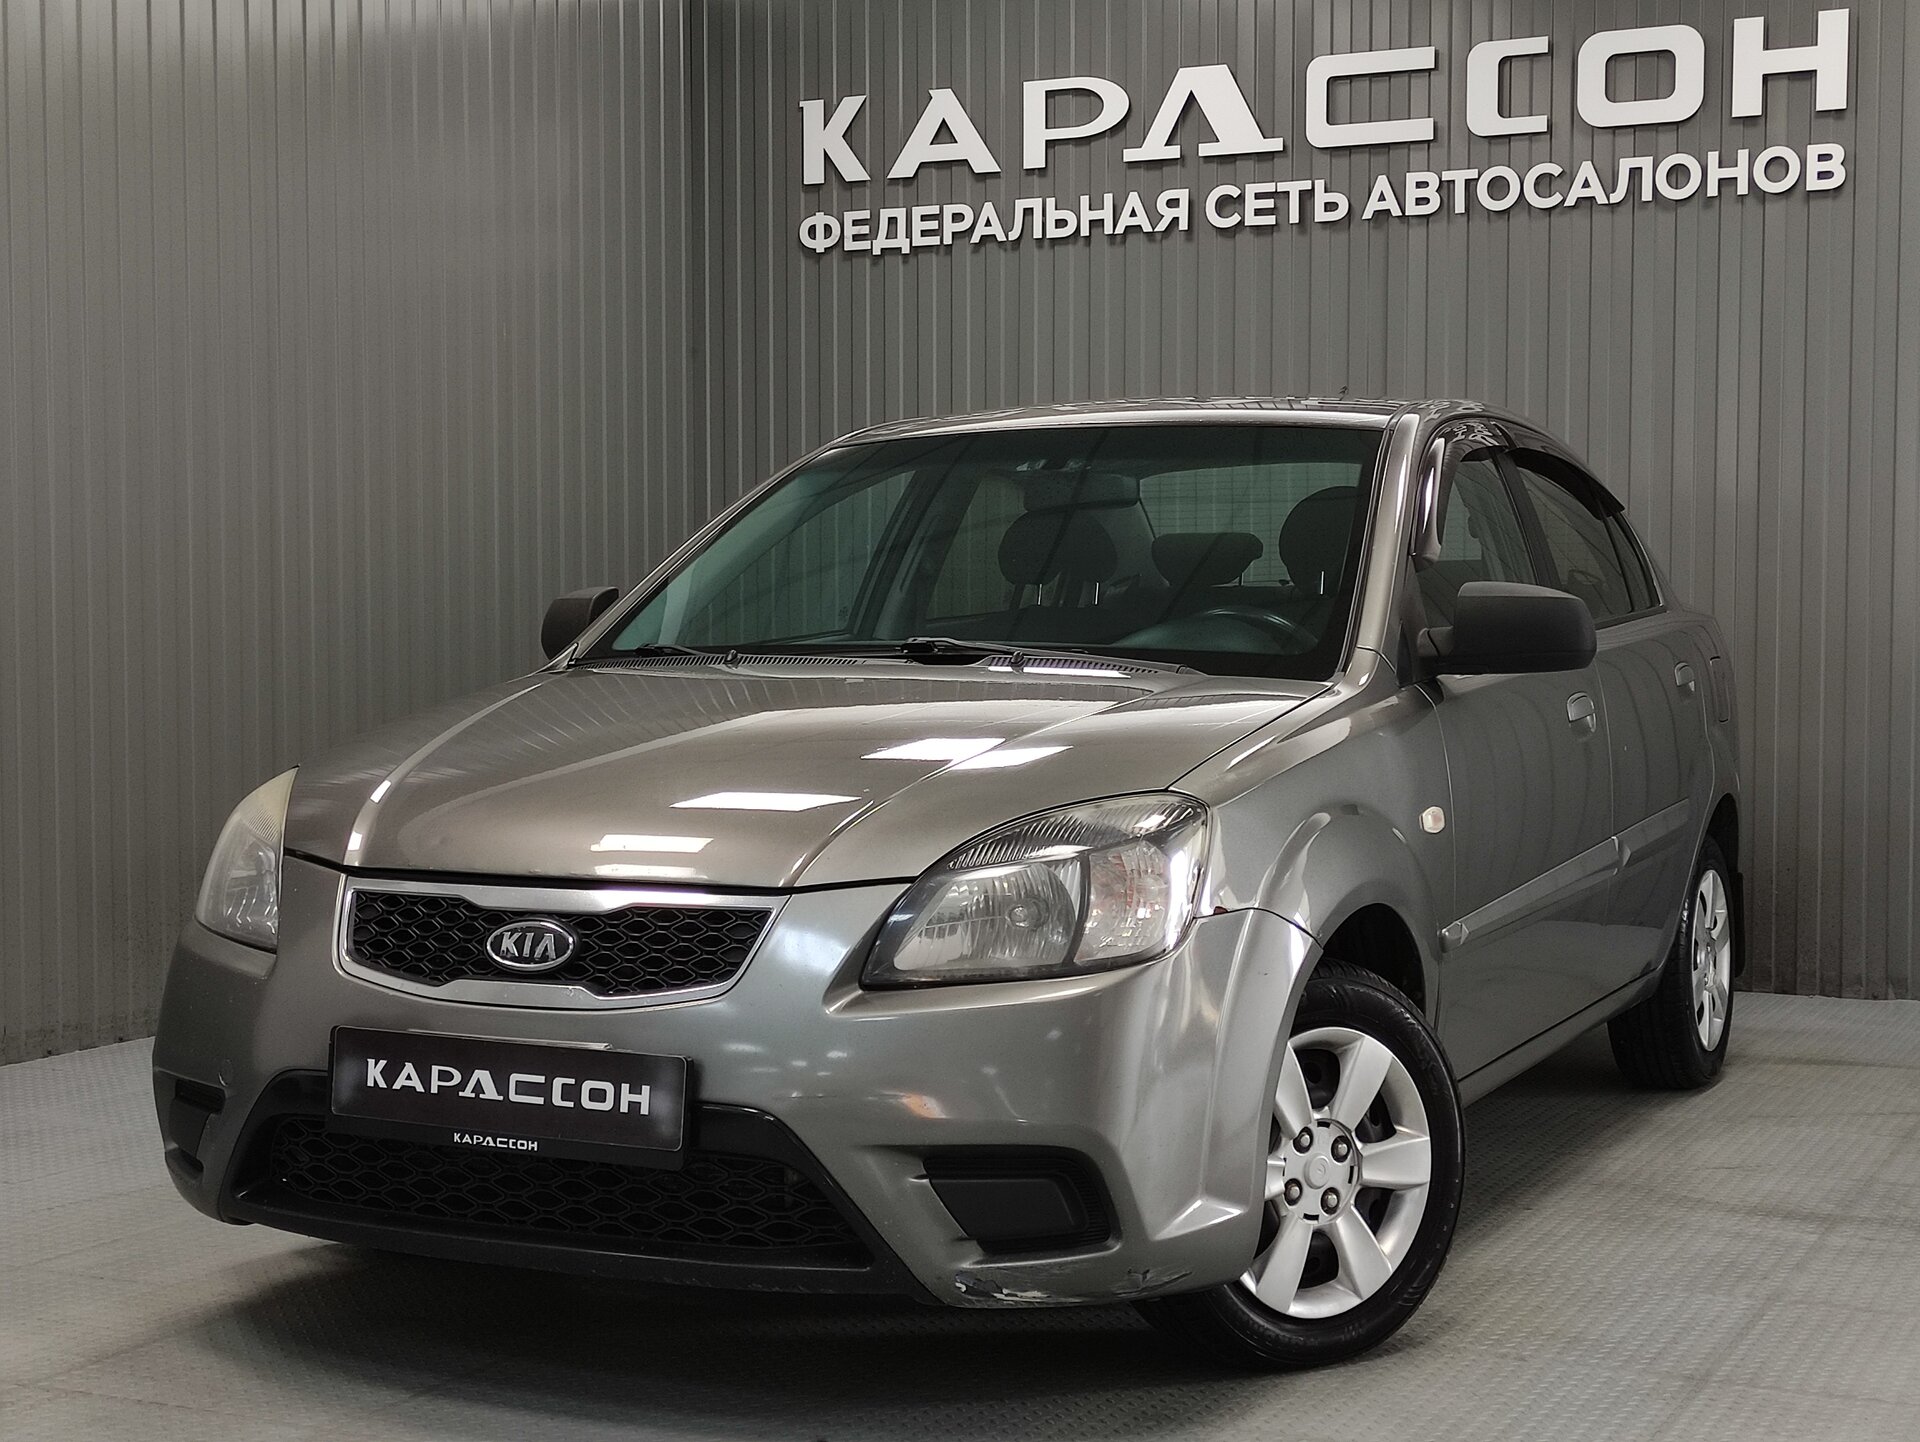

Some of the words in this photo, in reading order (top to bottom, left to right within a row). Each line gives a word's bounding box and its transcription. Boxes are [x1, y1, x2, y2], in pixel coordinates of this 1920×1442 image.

[799, 188, 1190, 255] ФЕДЕРАЛЬНАЯ
[1205, 179, 1350, 228] СЕТЬ
[1361, 143, 1847, 220] АВТОСАЛОНОВ
[499, 931, 557, 960] KIA
